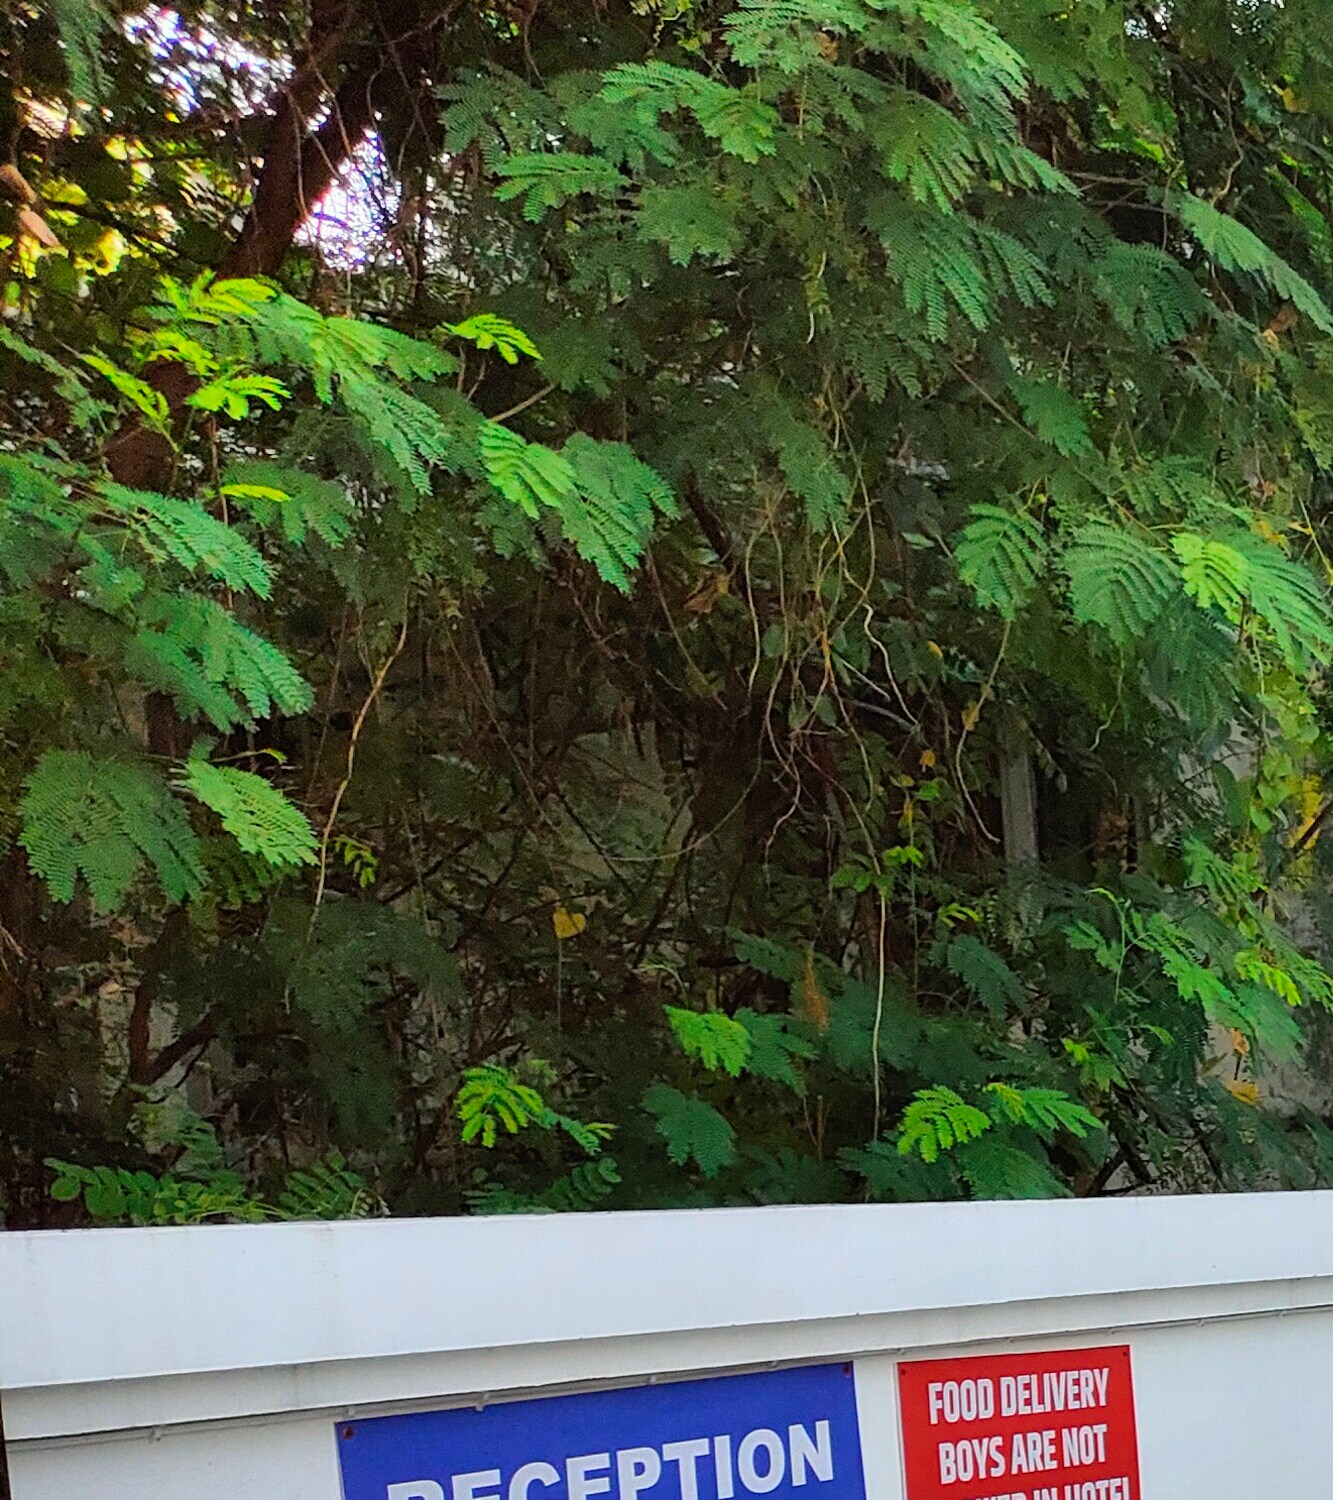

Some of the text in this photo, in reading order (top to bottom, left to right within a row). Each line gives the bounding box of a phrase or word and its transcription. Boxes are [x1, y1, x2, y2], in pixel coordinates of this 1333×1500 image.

[928, 1368, 1110, 1425] FOOD DELIVERY
[938, 1424, 1108, 1485] BOYS ARE NOT
